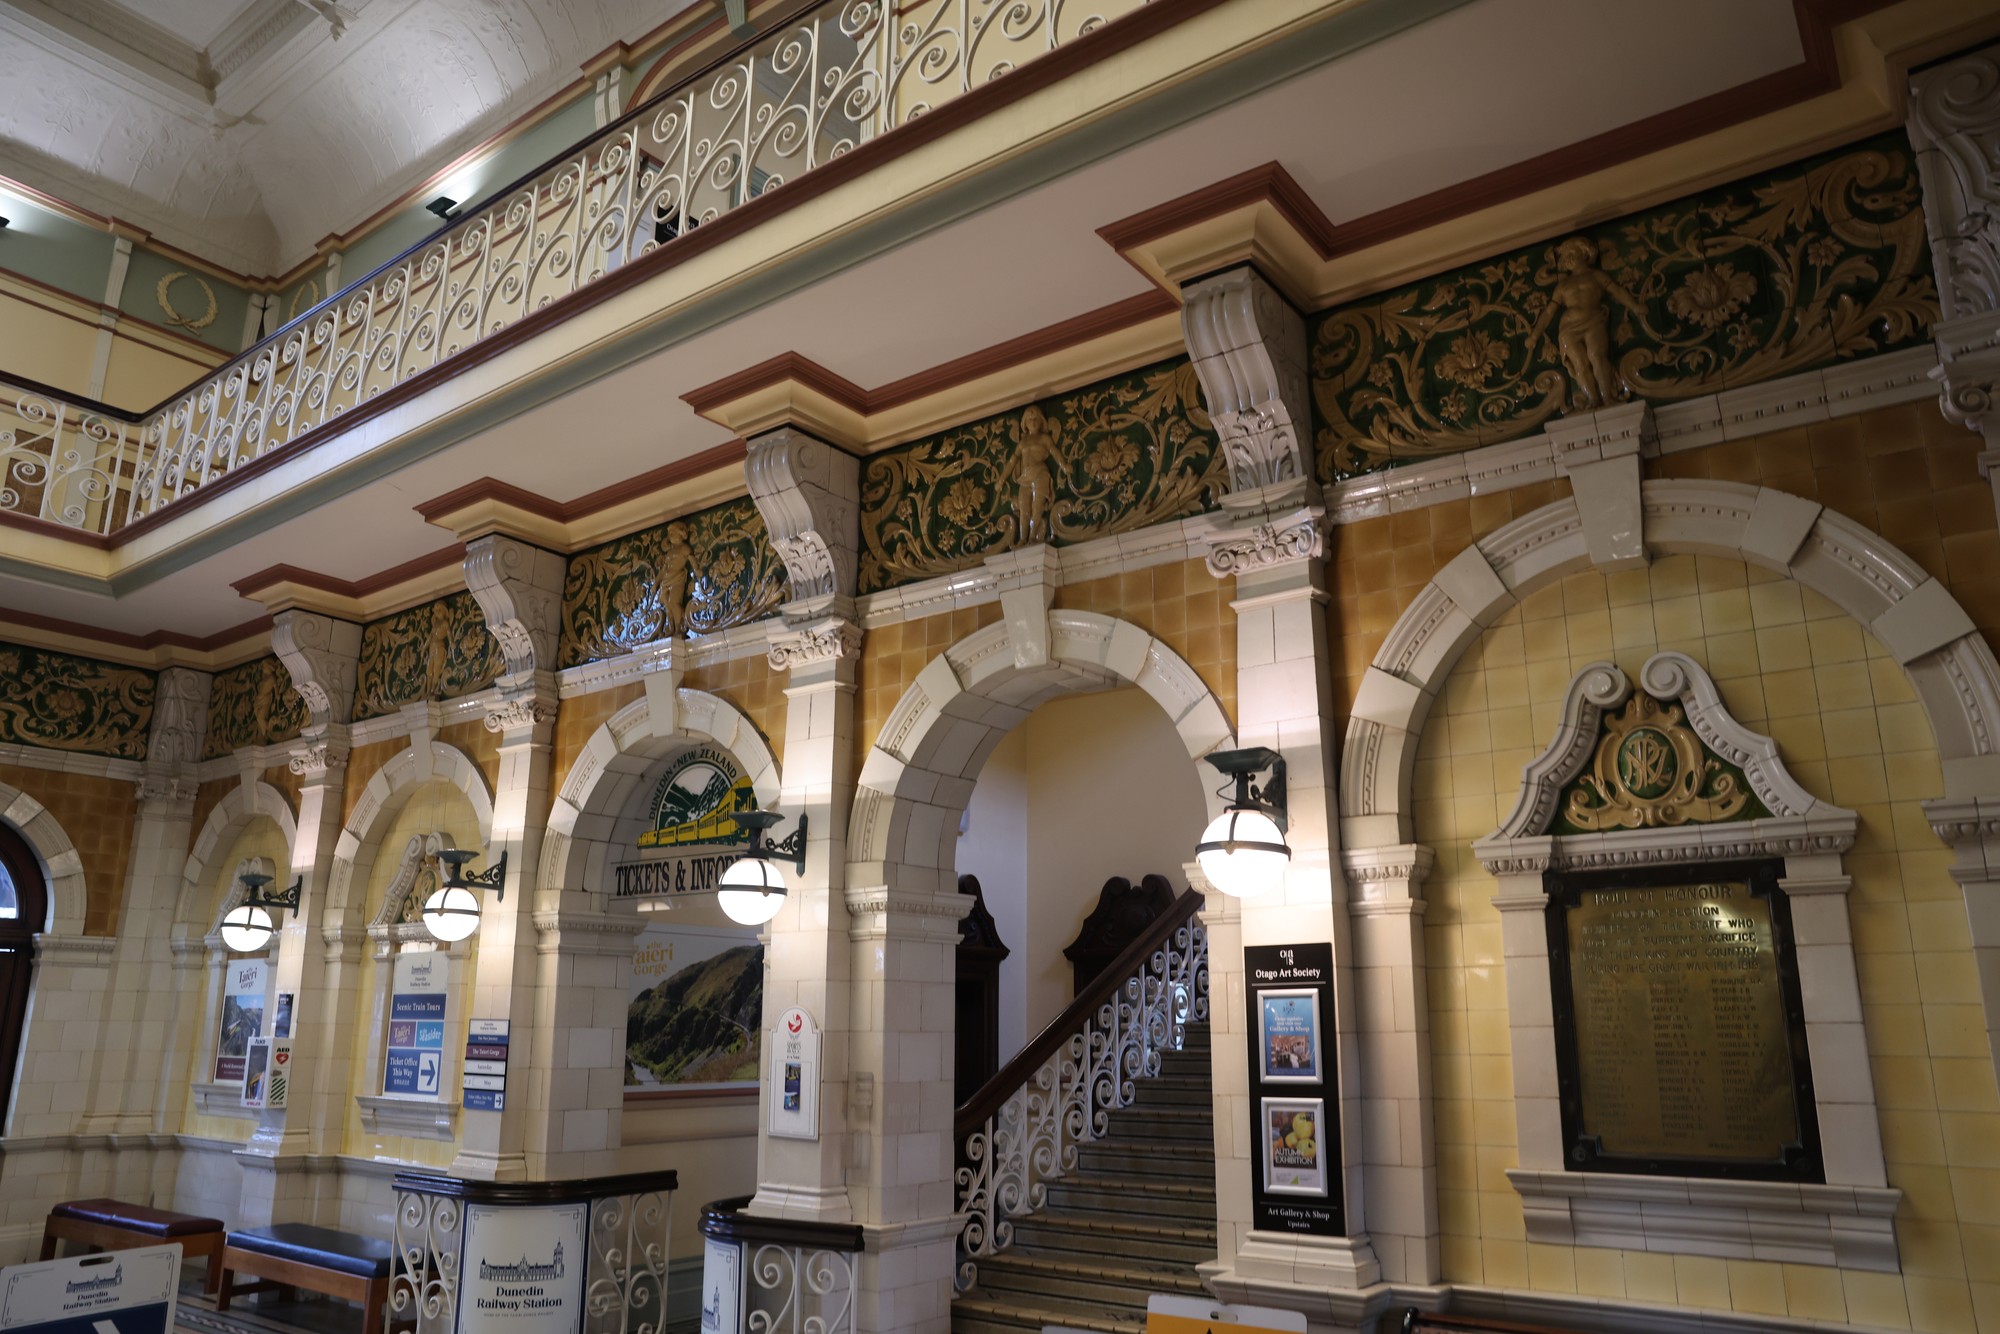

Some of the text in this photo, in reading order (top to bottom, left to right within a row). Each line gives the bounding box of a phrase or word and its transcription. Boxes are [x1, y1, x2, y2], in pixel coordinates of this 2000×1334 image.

[649, 748, 737, 820] DUNEDIN NEW ZEALAND
[615, 860, 670, 897] TICKETS
[675, 859, 686, 892] &
[1595, 891, 1632, 906] ROLL
[1665, 885, 1733, 902] HONOUR
[1668, 906, 1719, 918] SECTION
[1663, 921, 1682, 932] THE
[1689, 919, 1721, 931] STAFF
[1728, 918, 1754, 929] WHO
[1643, 934, 1696, 946] SUPREME
[1610, 949, 1639, 961] THEIR
[1645, 948, 1669, 960] KING
[1675, 948, 1697, 958] AND
[1255, 967, 1321, 981] Otago Art Society
[1584, 963, 1619, 976] DURING
[1626, 963, 1643, 974] THE
[1649, 962, 1682, 975] GREAT
[1687, 961, 1709, 972] WAR
[397, 1003, 440, 1011] Scenic Train Tours
[390, 1057, 418, 1066] Ticket Office
[393, 1067, 413, 1079] This Way
[1276, 1148, 1304, 1157] AUTUMN
[1275, 1156, 1313, 1165] EXHIBITION
[1268, 1207, 1330, 1221] Art Gallery & Shop
[1287, 1220, 1310, 1229] Upstairs
[77, 1291, 108, 1301] Dunedin
[496, 1286, 544, 1297] Dunedin
[63, 1300, 92, 1311] Railway
[94, 1296, 120, 1305] Station
[477, 1297, 562, 1311] Railway Station
